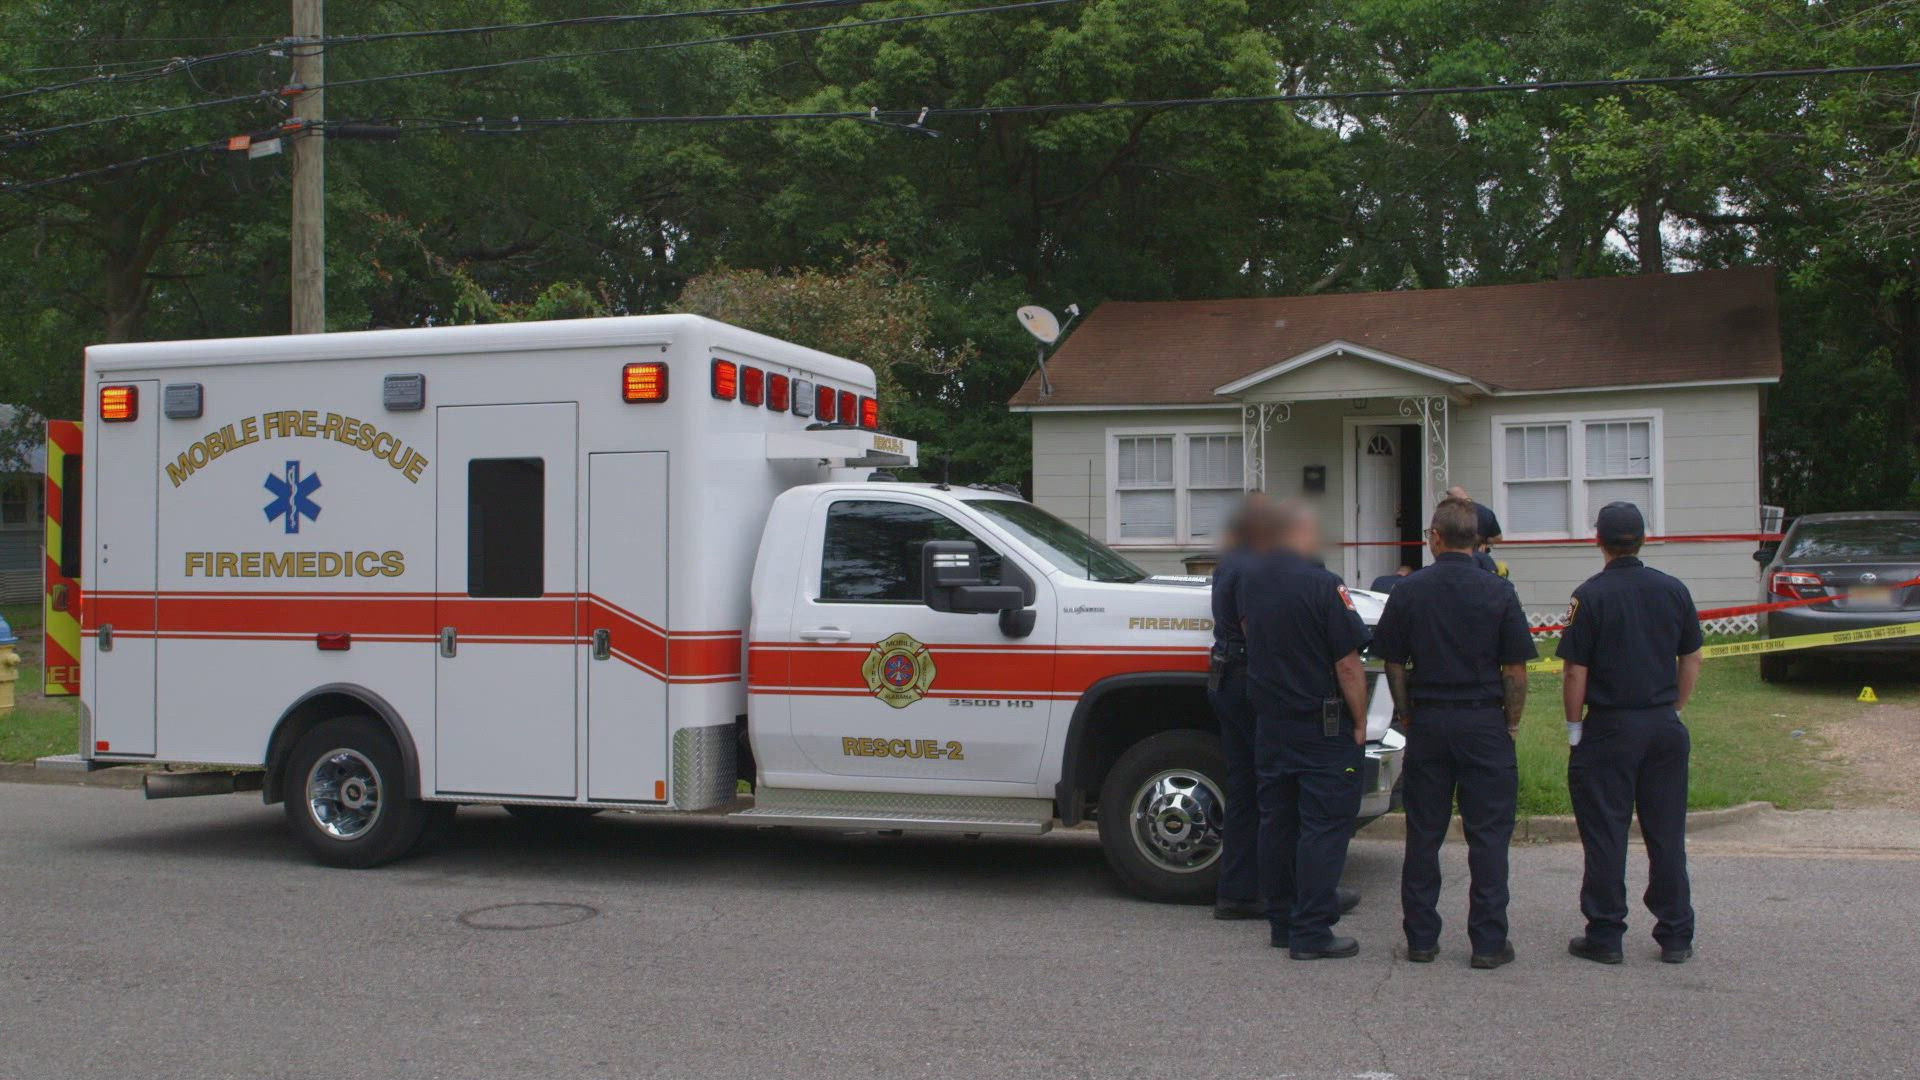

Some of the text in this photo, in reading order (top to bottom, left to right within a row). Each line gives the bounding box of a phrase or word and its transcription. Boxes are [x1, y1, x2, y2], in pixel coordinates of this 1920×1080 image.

[165, 410, 429, 488] MOBILE FIRE-RESCUE
[185, 551, 406, 577] FIREMEDICS
[949, 699, 1034, 709] 3500 HD
[841, 737, 965, 761] RESCUE-2
